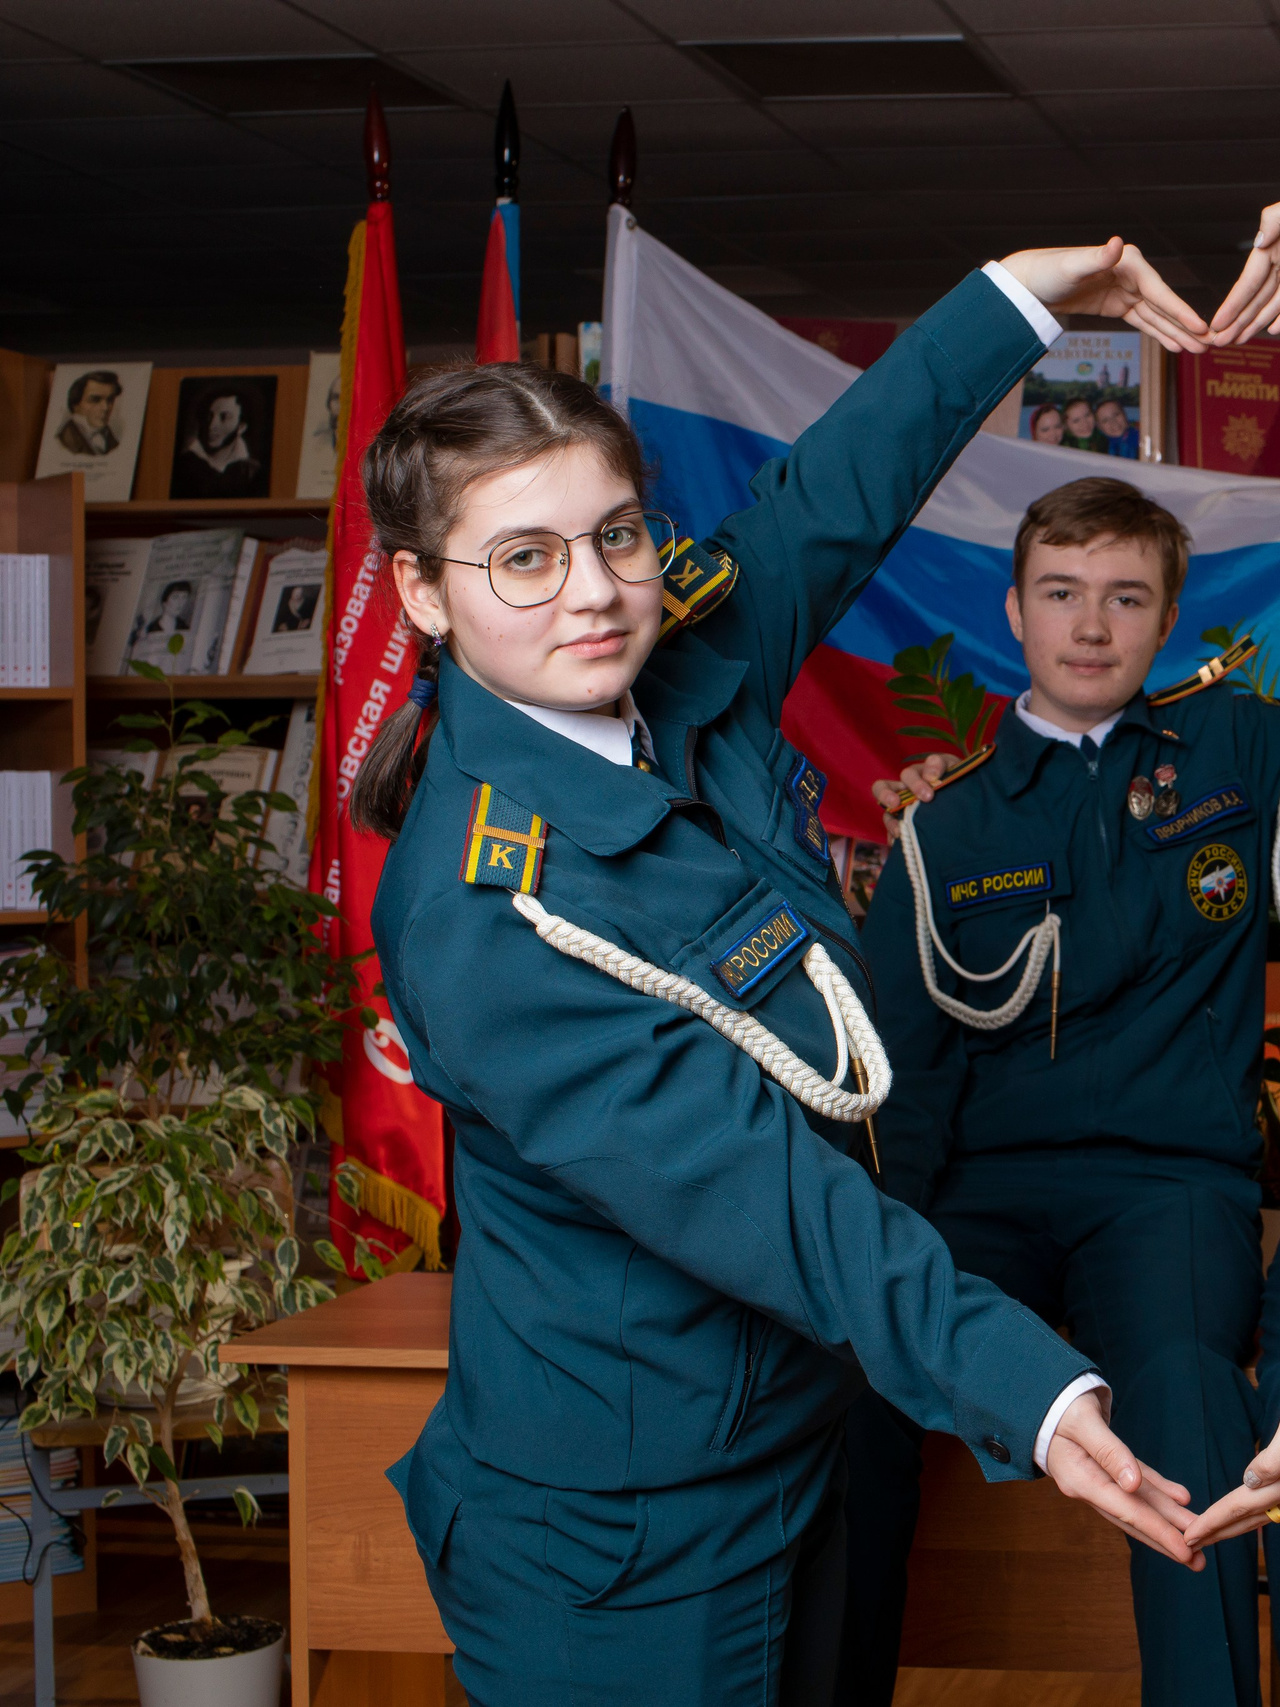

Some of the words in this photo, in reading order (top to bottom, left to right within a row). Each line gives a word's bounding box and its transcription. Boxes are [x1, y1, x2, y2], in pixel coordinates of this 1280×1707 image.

[1206, 378, 1280, 402] ПАМЯТИ
[668, 558, 704, 590] К
[333, 535, 385, 686] разовате
[335, 678, 392, 820] овская
[379, 604, 414, 676] шк
[1154, 797, 1223, 840] ДВОРНИКОВ
[487, 843, 517, 869] К
[1189, 861, 1203, 886] МЧС
[1204, 846, 1243, 874] РОССИИ
[950, 880, 978, 904] МЧС
[982, 867, 1045, 895] РОССИИ
[730, 913, 798, 977] РОССИИ
